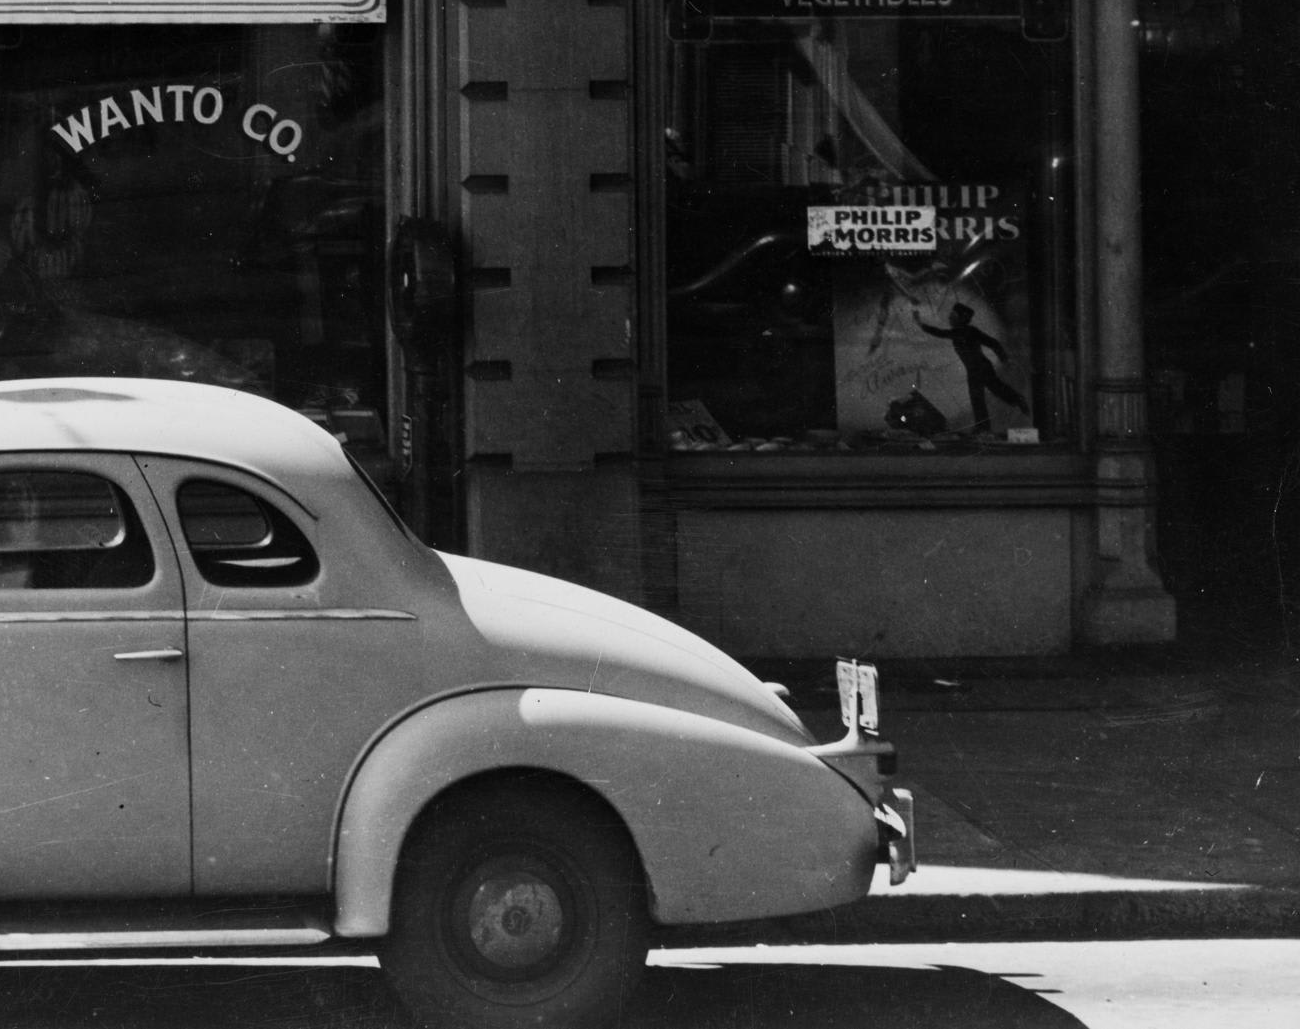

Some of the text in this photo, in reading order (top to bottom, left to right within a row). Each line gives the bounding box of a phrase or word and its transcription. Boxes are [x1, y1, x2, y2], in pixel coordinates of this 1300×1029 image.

[51, 84, 303, 163] WANTO CO.
[834, 210, 922, 225] PHILIP
[834, 227, 934, 243] MORRIS
[936, 216, 1021, 240] RRIS
